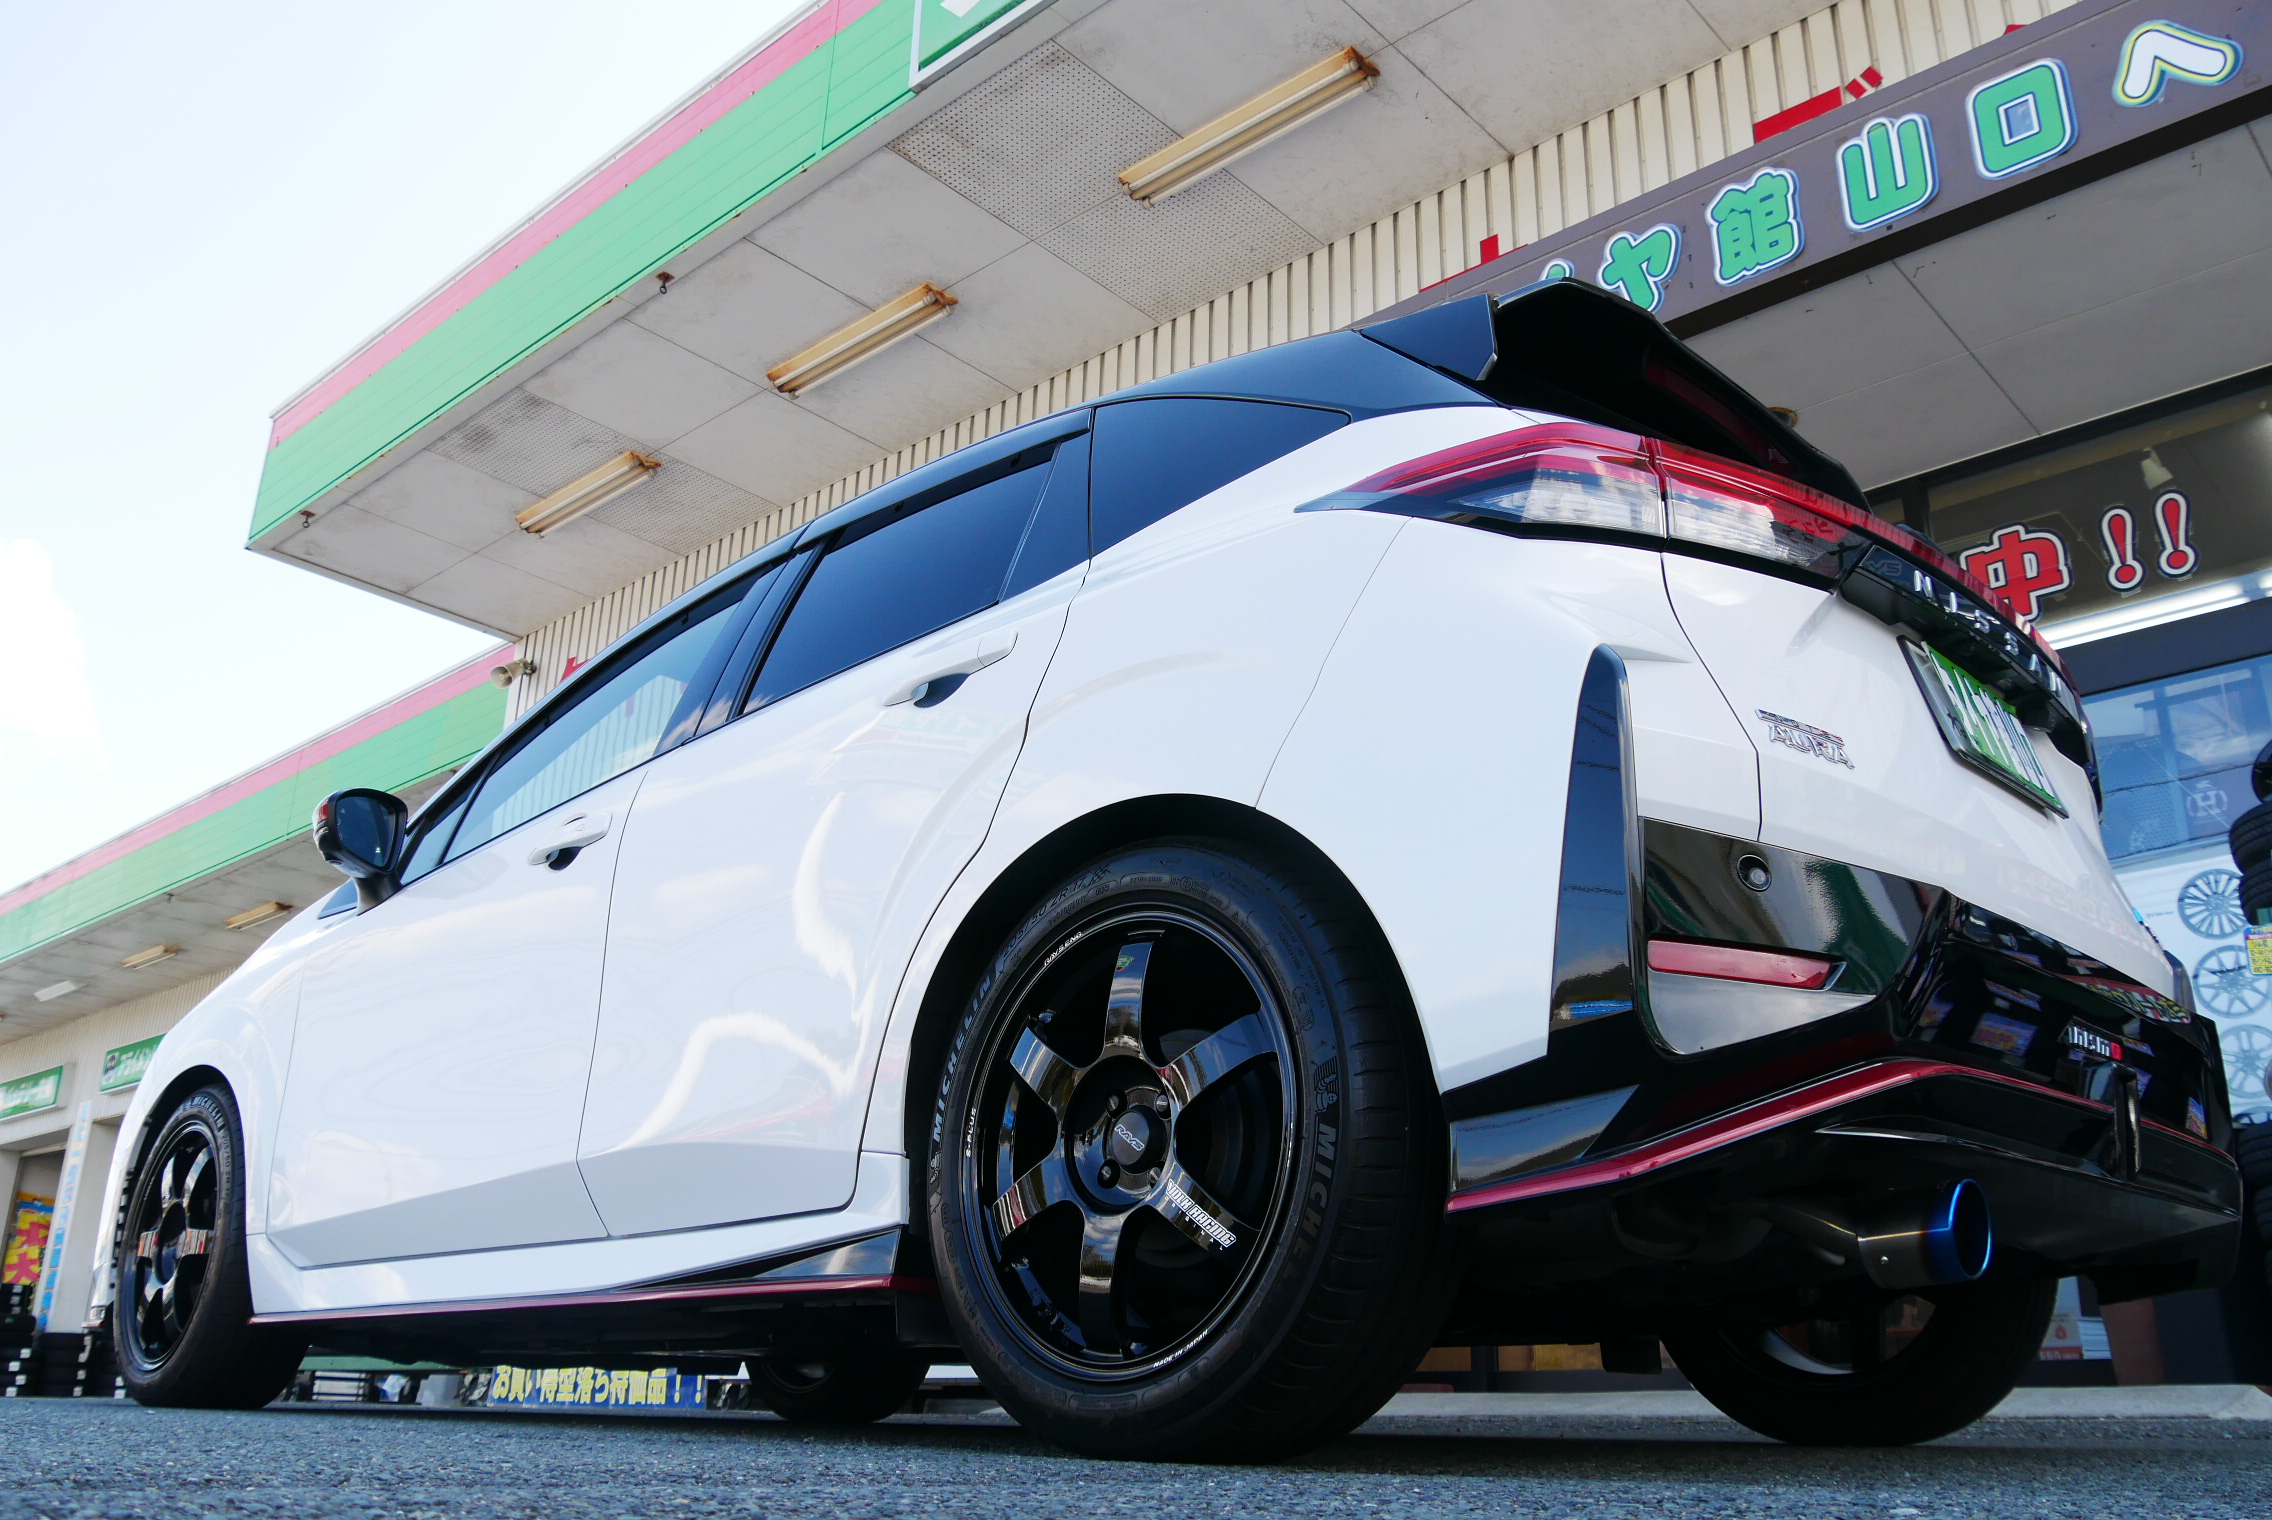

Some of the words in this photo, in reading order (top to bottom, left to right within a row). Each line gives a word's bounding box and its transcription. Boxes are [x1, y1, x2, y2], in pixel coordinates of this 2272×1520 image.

[1540, 19, 2243, 314] ヤ館山口へ
[1913, 570, 2062, 698] NISSAN
[1768, 723, 1855, 770] AURA
[933, 975, 992, 1144] MICHELIN
[191, 1095, 225, 1133] MICHELIN
[1114, 1123, 1145, 1152] RAYS
[1186, 1203, 1237, 1248] RACING
